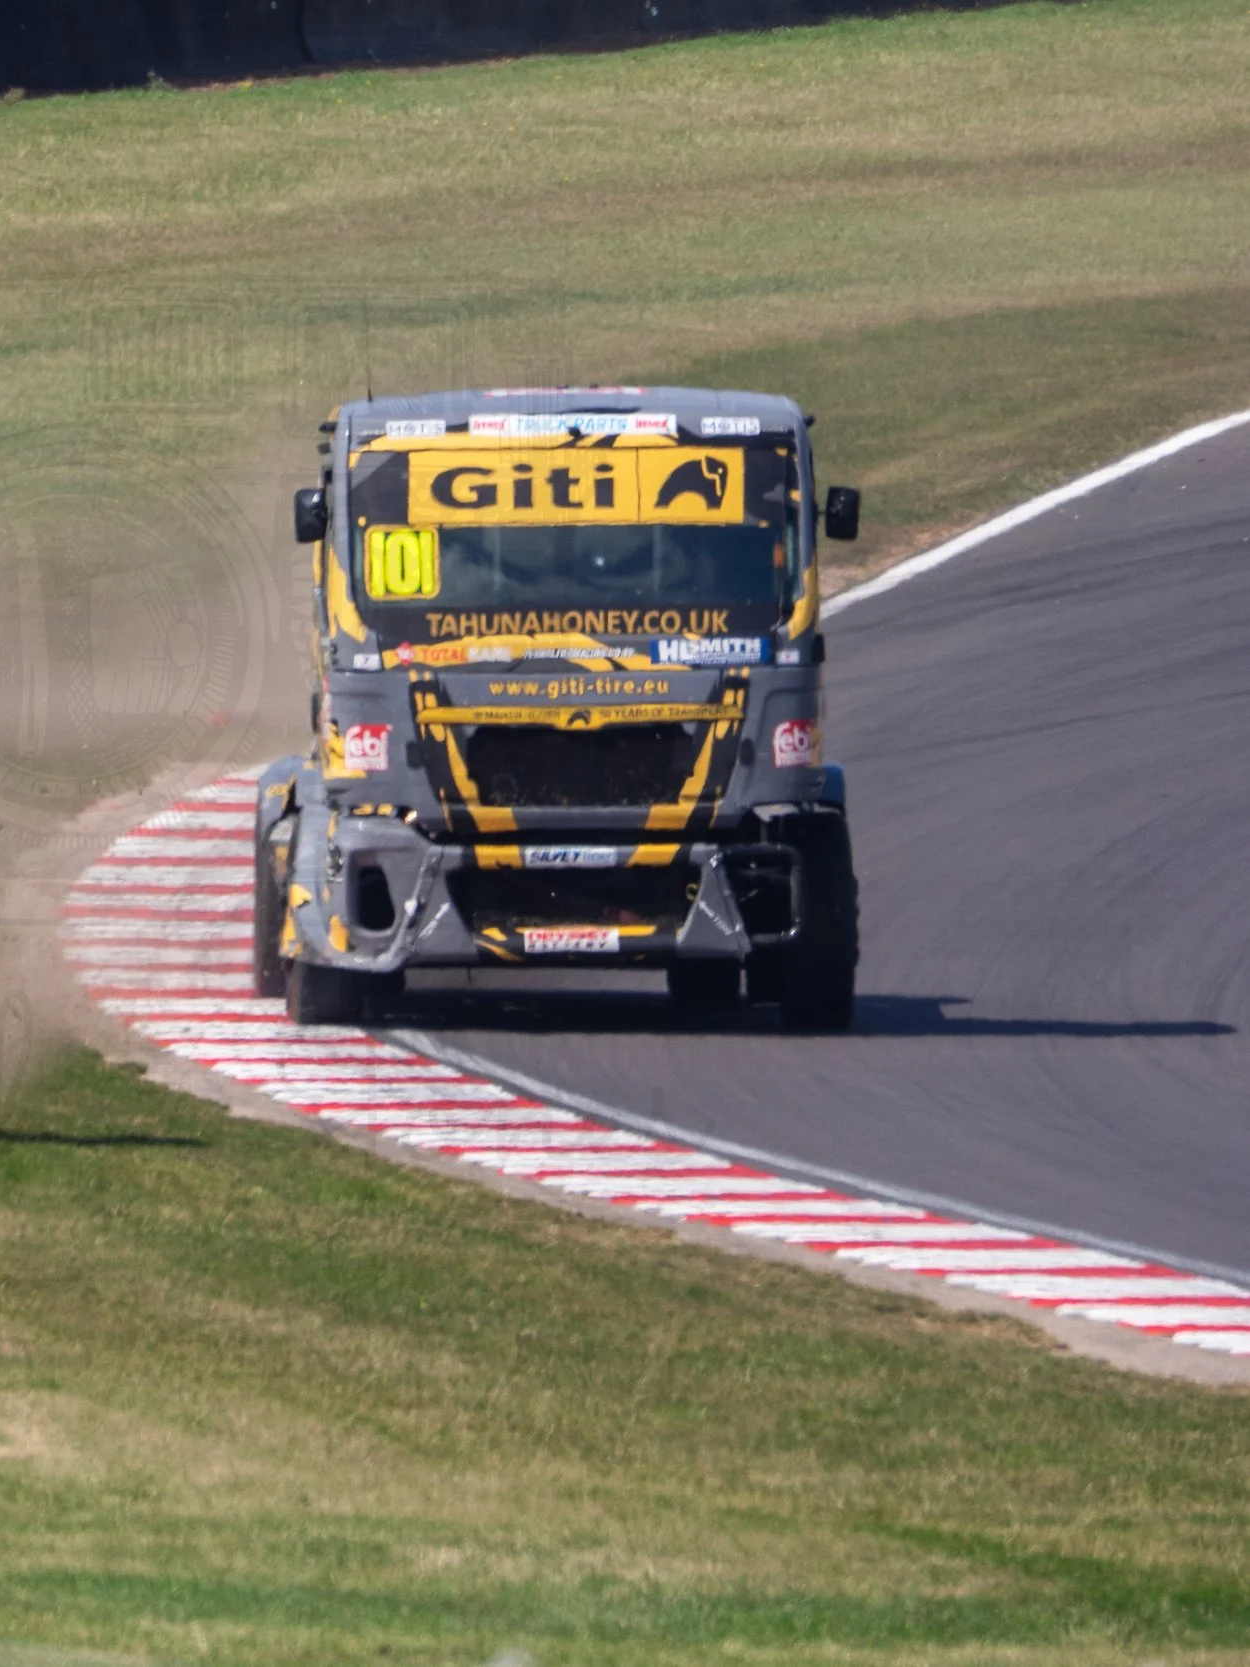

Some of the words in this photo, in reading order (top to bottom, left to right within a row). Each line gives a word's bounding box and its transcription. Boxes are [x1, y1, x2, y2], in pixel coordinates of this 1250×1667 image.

[571, 417, 628, 432] PARTS
[431, 463, 615, 510] Giti
[370, 529, 432, 596] 101
[425, 608, 729, 637] TAHUNAHONEY.CO.UK
[488, 678, 670, 699] www.giti-tire.eu
